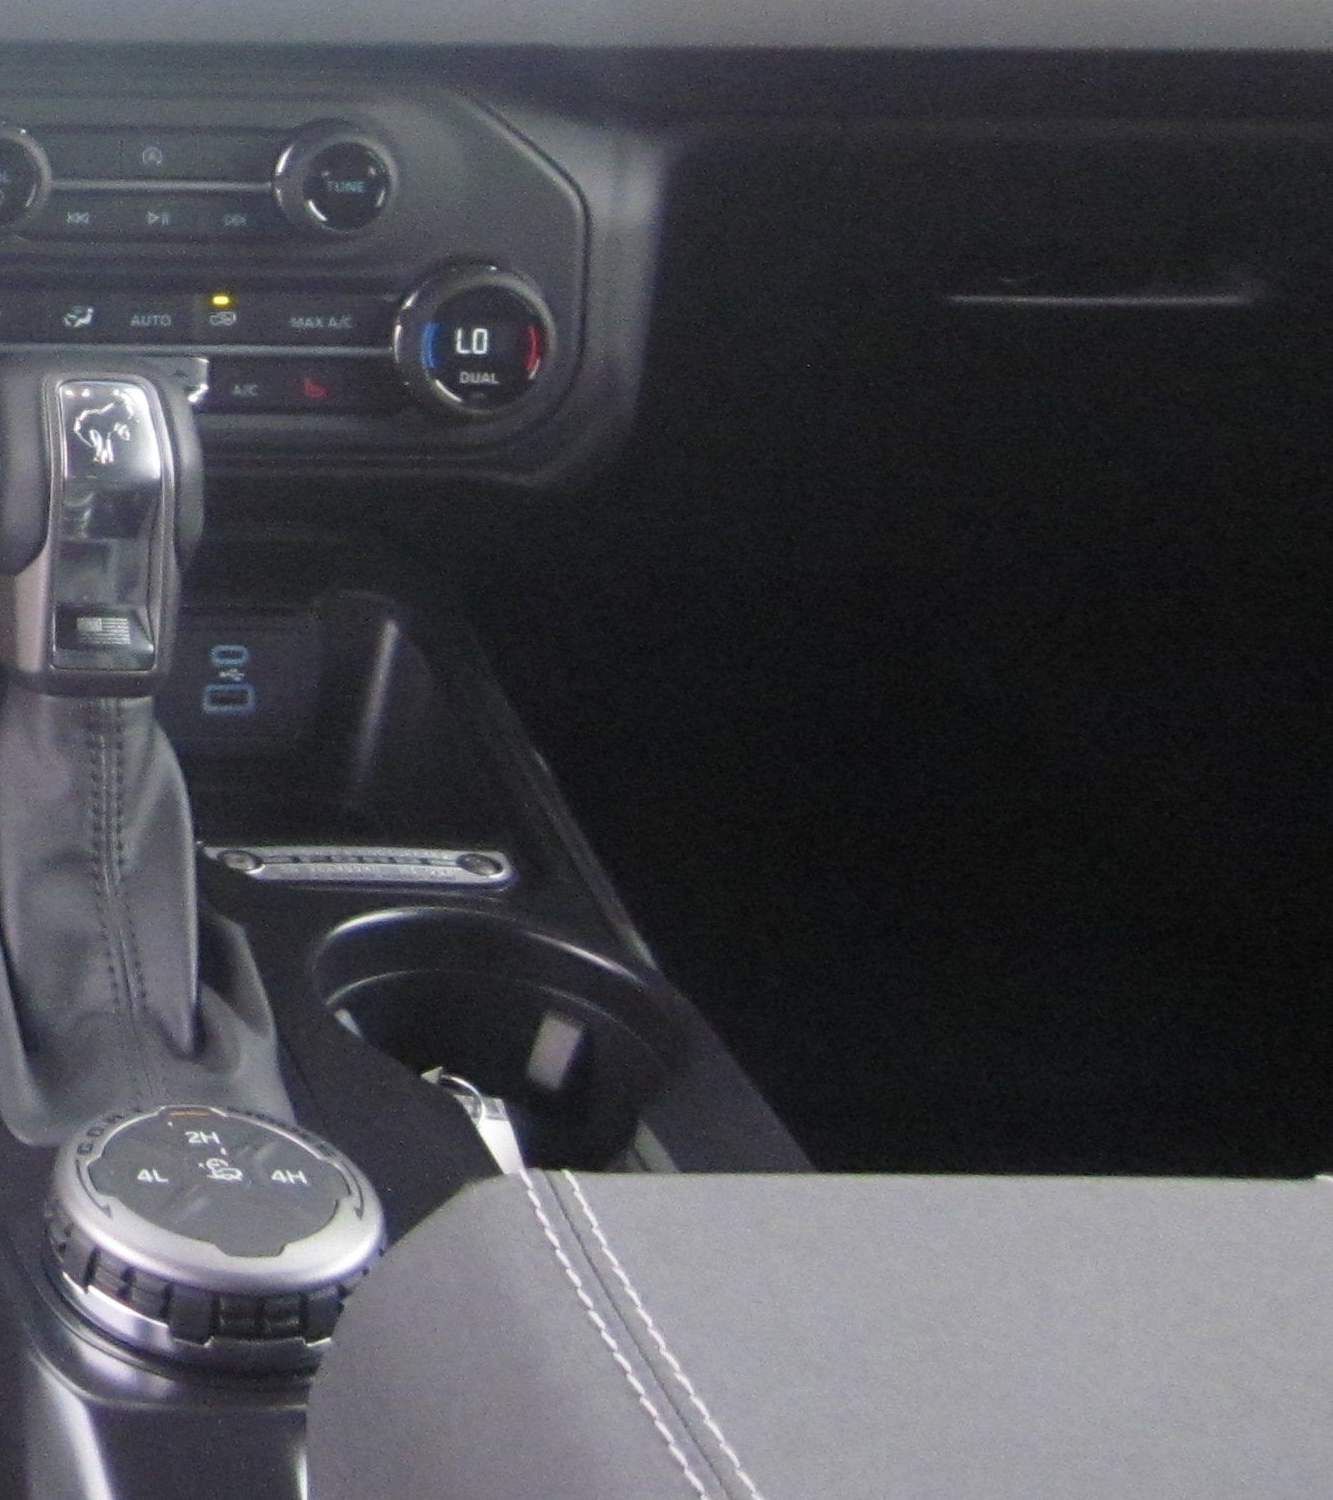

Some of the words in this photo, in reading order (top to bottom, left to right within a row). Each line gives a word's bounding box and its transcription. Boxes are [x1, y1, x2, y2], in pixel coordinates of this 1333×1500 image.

[130, 313, 173, 327] AUTO
[289, 315, 324, 329] MAX
[455, 327, 488, 354] LO
[459, 370, 500, 385] DUAL
[184, 1130, 221, 1145] 2H
[136, 1169, 170, 1184] 4L
[270, 1168, 309, 1185] 4H
